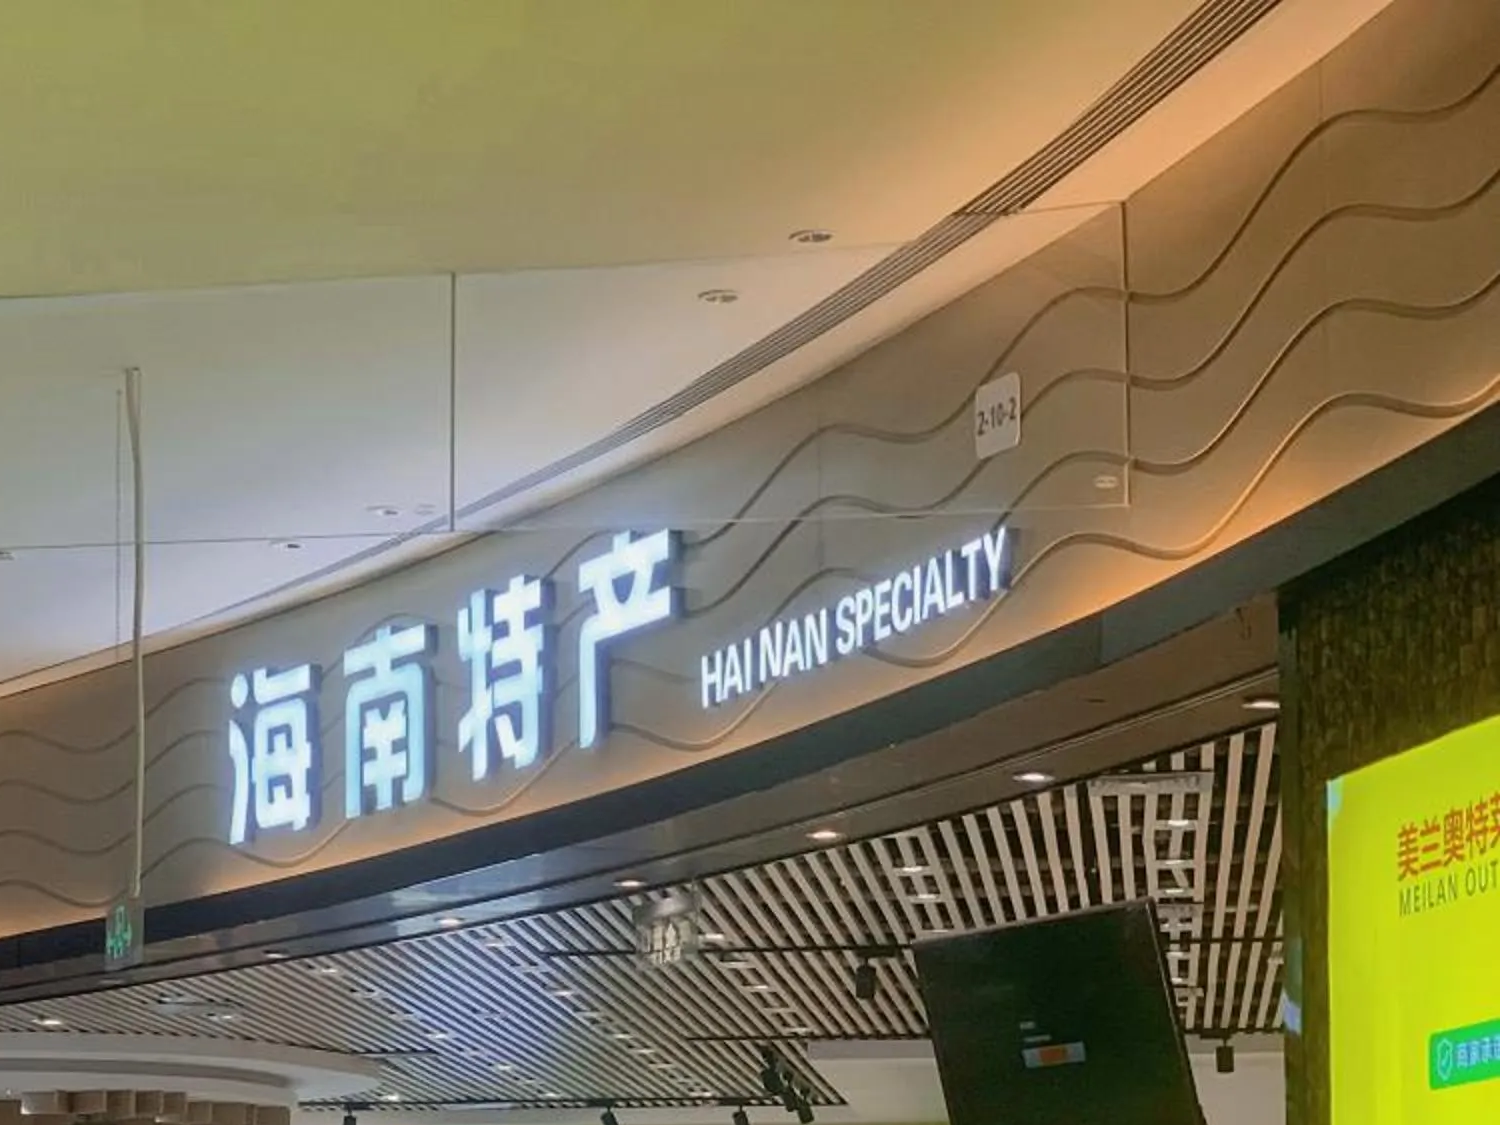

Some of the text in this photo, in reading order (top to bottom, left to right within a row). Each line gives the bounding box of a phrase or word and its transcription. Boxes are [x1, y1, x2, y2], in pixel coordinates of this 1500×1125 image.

[977, 396, 1017, 437] 2-10-2
[228, 527, 674, 846] 海南特产
[700, 527, 1011, 709] HAI NAN SPECIALTY
